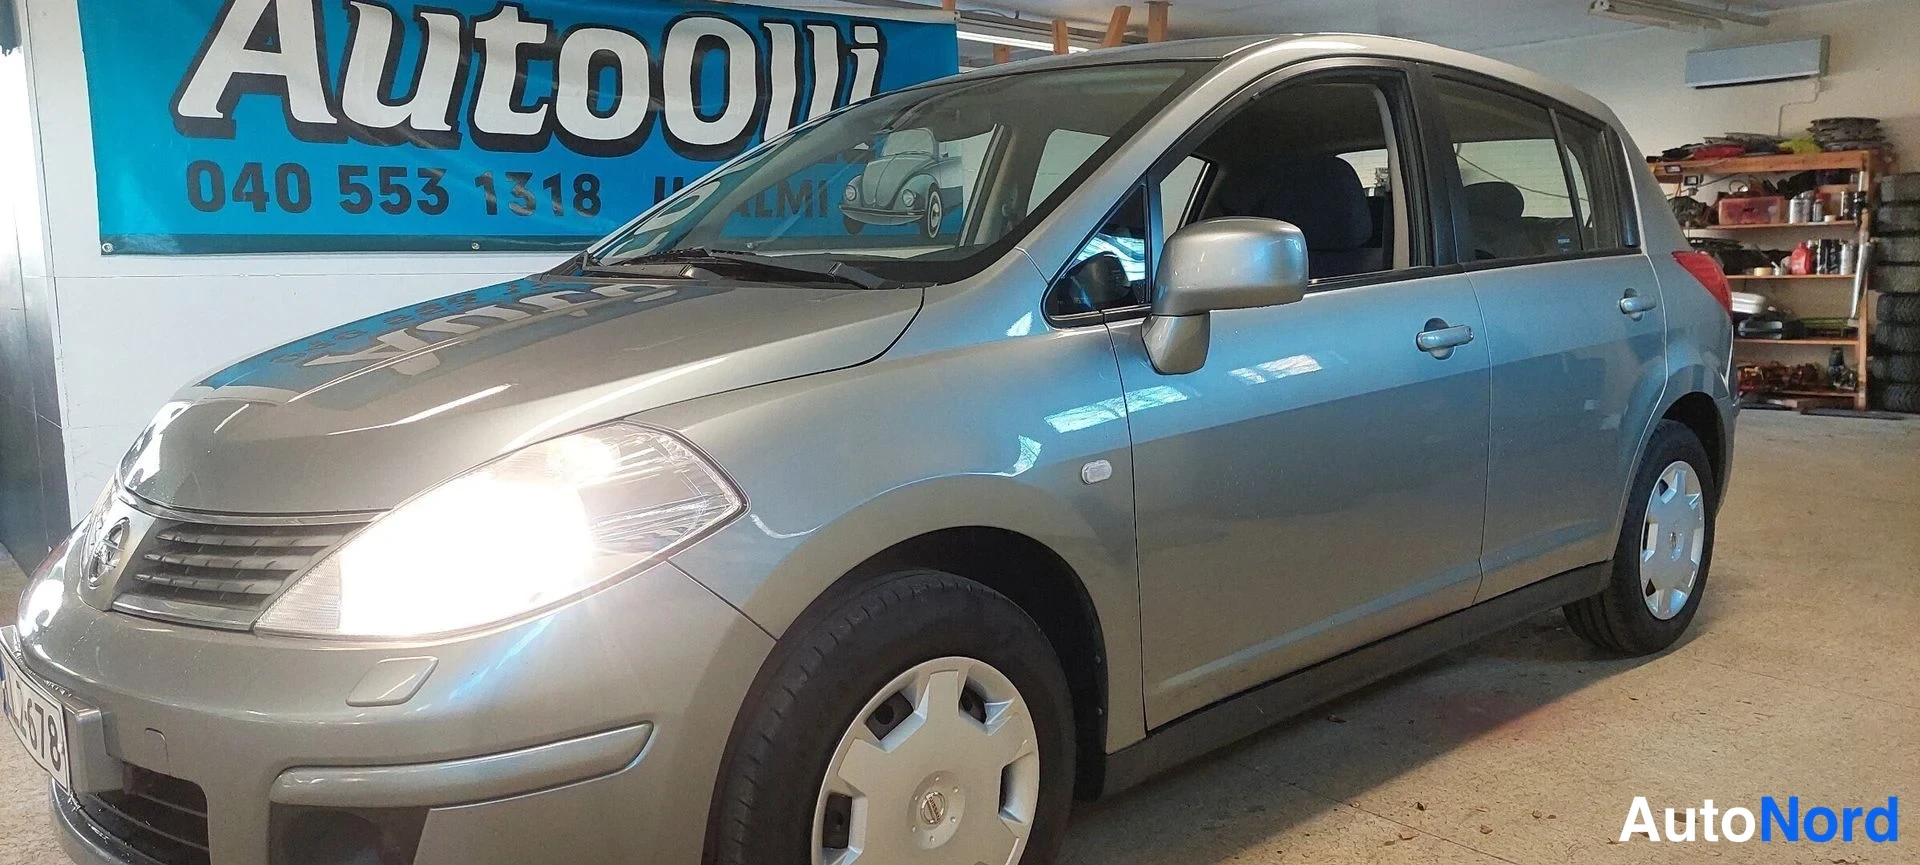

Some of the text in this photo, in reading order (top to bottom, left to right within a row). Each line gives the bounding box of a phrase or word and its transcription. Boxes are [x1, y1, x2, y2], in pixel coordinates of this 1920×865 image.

[172, 0, 884, 158] AutoOlli
[187, 160, 312, 214] 040
[338, 164, 450, 216] 553
[474, 171, 602, 218] 1318
